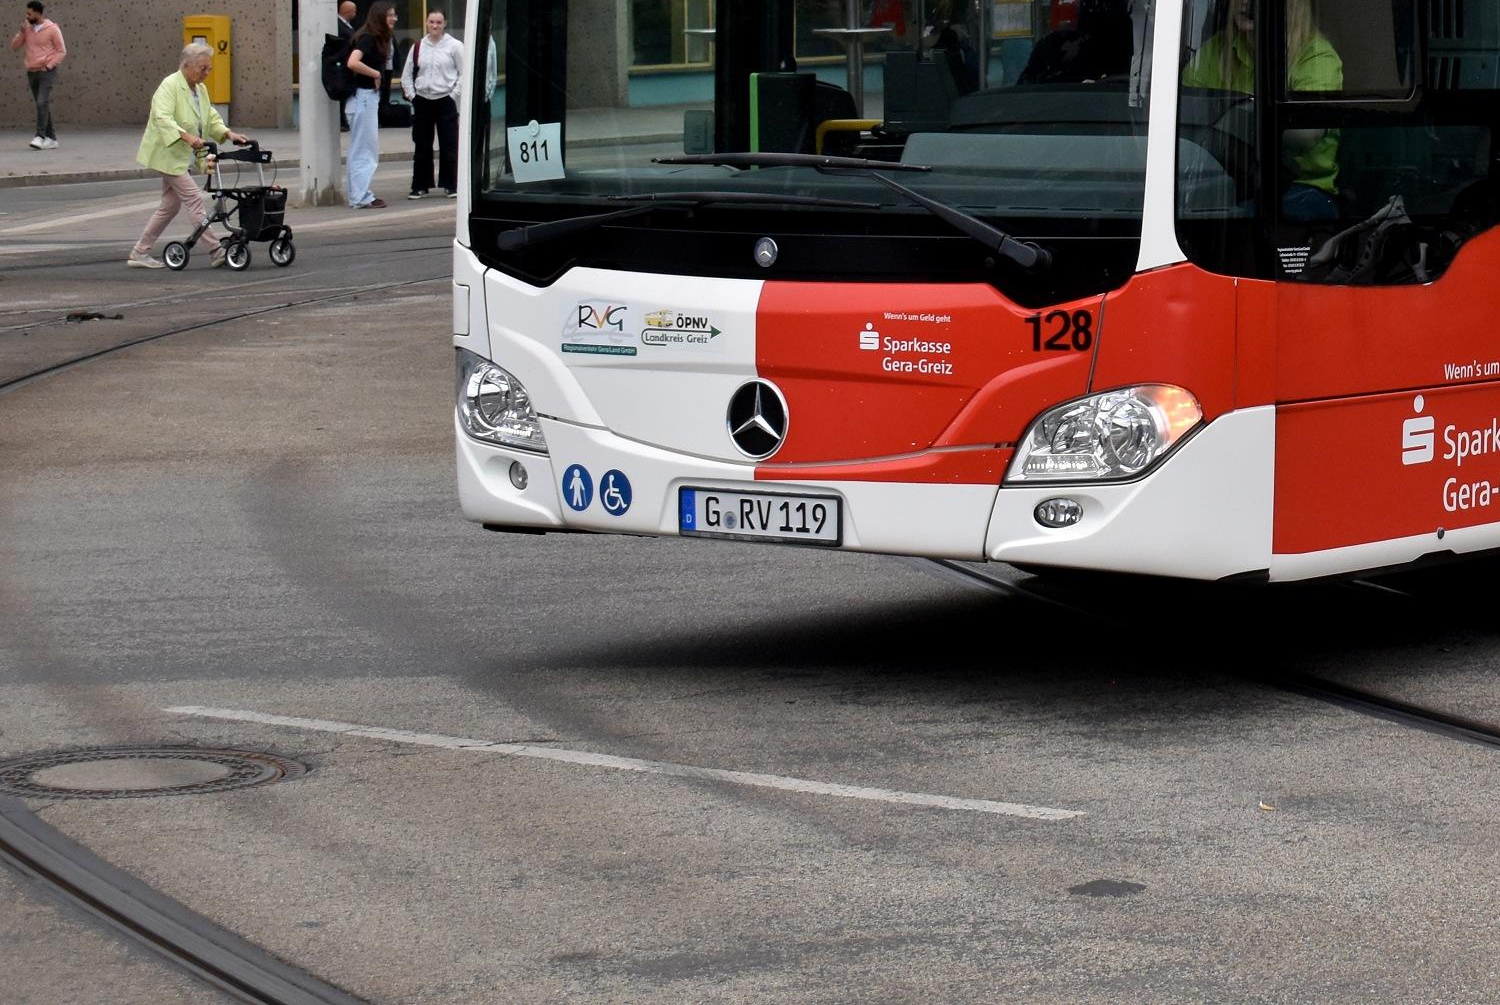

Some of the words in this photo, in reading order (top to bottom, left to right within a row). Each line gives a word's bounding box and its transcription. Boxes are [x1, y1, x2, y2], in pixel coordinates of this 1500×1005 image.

[519, 139, 550, 164] 811
[578, 304, 627, 332] RVG
[676, 313, 708, 329] ÖPNV
[883, 312, 907, 321] Wenn's
[920, 313, 935, 322] Geld
[936, 314, 951, 324] geht
[645, 332, 684, 343] Landkreis
[686, 334, 708, 344] Greiz
[1025, 309, 1092, 352] 128
[883, 336, 951, 354] Sparkasse
[882, 357, 952, 375] Gera-Greiz
[1444, 360, 1481, 380] Wenn's
[1484, 361, 1500, 375] um
[686, 514, 692, 523] D
[705, 496, 720, 527] G
[740, 498, 772, 530] RV
[779, 501, 827, 534] 119
